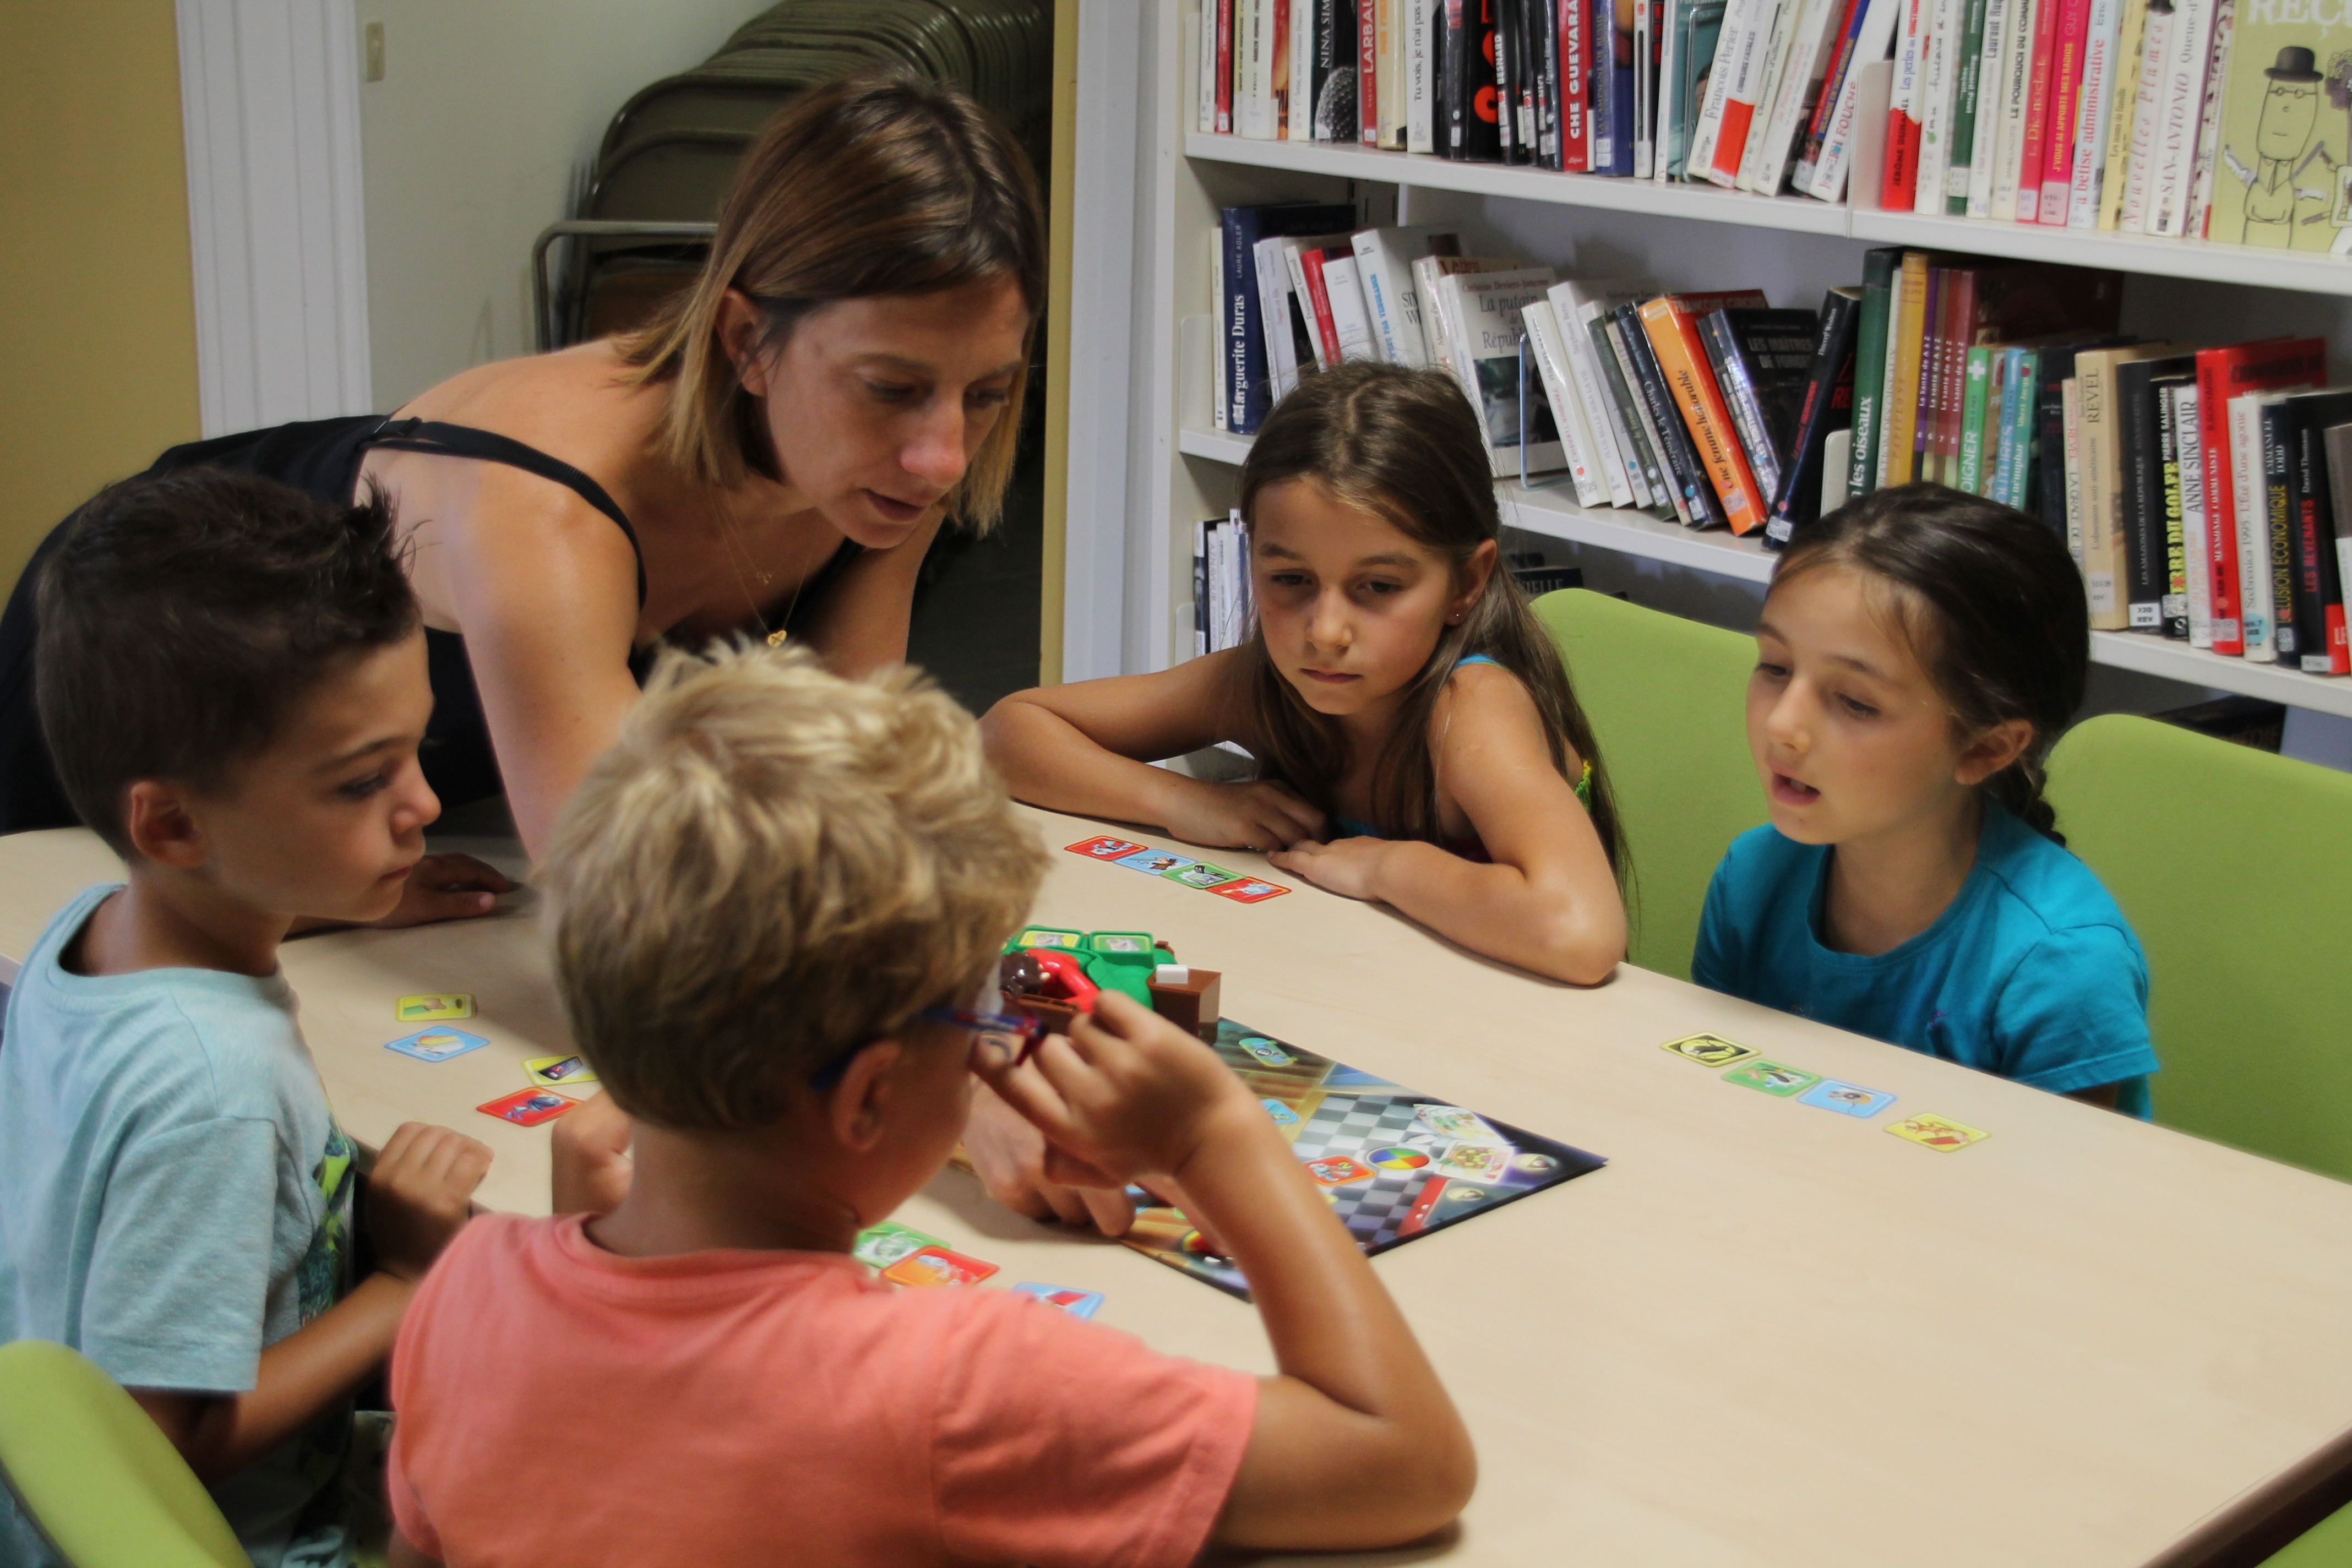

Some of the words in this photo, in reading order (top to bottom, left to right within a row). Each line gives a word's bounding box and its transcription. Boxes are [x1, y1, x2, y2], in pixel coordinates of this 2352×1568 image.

[1414, 7, 1424, 25] pas
[1321, 29, 1330, 68] NINA
[1413, 49, 1424, 58] je
[1568, 0, 1579, 94] GUEVARA
[1597, 51, 1602, 62] DE
[2016, 35, 2025, 49] DU
[1493, 35, 1505, 85] BESNARD
[1736, 62, 1748, 93] ERREURS
[1743, 31, 1755, 61] FATALES
[1901, 50, 1917, 74] perles
[2062, 42, 2073, 74] RADIOS
[1899, 75, 1911, 90] Les
[2010, 51, 2024, 105] POURQUOI
[2061, 76, 2069, 92] MES
[2078, 39, 2104, 143] administrative
[1414, 88, 1421, 101] Tu
[2114, 87, 2125, 113] famille
[1570, 102, 1580, 138] CHE
[2010, 107, 2018, 119] LE
[2055, 95, 2067, 130] APPORTÉ
[2114, 113, 2121, 122] de
[2120, 117, 2150, 225] Nouvelles
[2137, 23, 2164, 103] Plumes
[2056, 133, 2064, 141] AI
[2160, 72, 2190, 195] SAN-ANTONIO
[1289, 259, 1302, 286] Giroud
[1232, 294, 1244, 336] Duras
[1479, 295, 1496, 313] La
[1559, 303, 1569, 320] Bern
[1816, 331, 1831, 356] Thierry
[1943, 353, 1950, 362] A
[1580, 369, 1589, 382] VIE
[1921, 359, 1928, 369] de
[1931, 361, 1939, 372] de
[1942, 363, 1950, 374] de
[1955, 364, 1962, 375] de
[1642, 379, 1664, 417] Charles
[1674, 368, 1707, 427] honorable
[1919, 372, 1928, 395] Santé
[1953, 377, 1962, 400] santé
[2083, 367, 2100, 423] REVEL
[1918, 397, 1925, 407] La
[1929, 398, 1936, 408] La
[1940, 400, 1947, 411] La
[1952, 402, 1959, 412] La
[2158, 386, 2169, 429] SALINGER
[1657, 416, 1668, 427] le
[1852, 395, 1872, 460] oiseaux
[2176, 400, 2201, 470] SINCLAIR
[2235, 411, 2248, 448] agonie
[1660, 426, 1685, 476] Téméraire
[1700, 424, 1725, 465] femme
[2067, 428, 2078, 462] REVEL
[2160, 431, 2171, 460] PIERRE
[2262, 418, 2275, 474] EMMANUEL
[2275, 444, 2285, 472] TODD
[2299, 428, 2309, 466] Thomson
[1849, 462, 1865, 487] les
[2010, 442, 2024, 493] nénuphar
[2086, 437, 2098, 502] anti-américaine
[2134, 455, 2145, 503] RÉPUBLIQUE
[2208, 447, 2220, 509] COMMUNISTE
[2235, 451, 2248, 482] d'une
[2300, 469, 2310, 492] David
[2162, 462, 2181, 518] GOLFE
[2182, 472, 2203, 514] ANNE
[2236, 484, 2250, 511] L'Été
[2137, 503, 2144, 514] LA
[2138, 516, 2146, 526] DE
[2089, 504, 2100, 549] L'obsession
[2166, 519, 2183, 544] DU
[2211, 512, 2223, 561] MENSONGE
[2267, 484, 2289, 565] ÉCONOMIQUE
[2301, 499, 2316, 566] REVENANTS
[2138, 527, 2147, 569] AMAZONES
[2241, 548, 2255, 608] Srebrenica
[2304, 570, 2317, 591] LES
